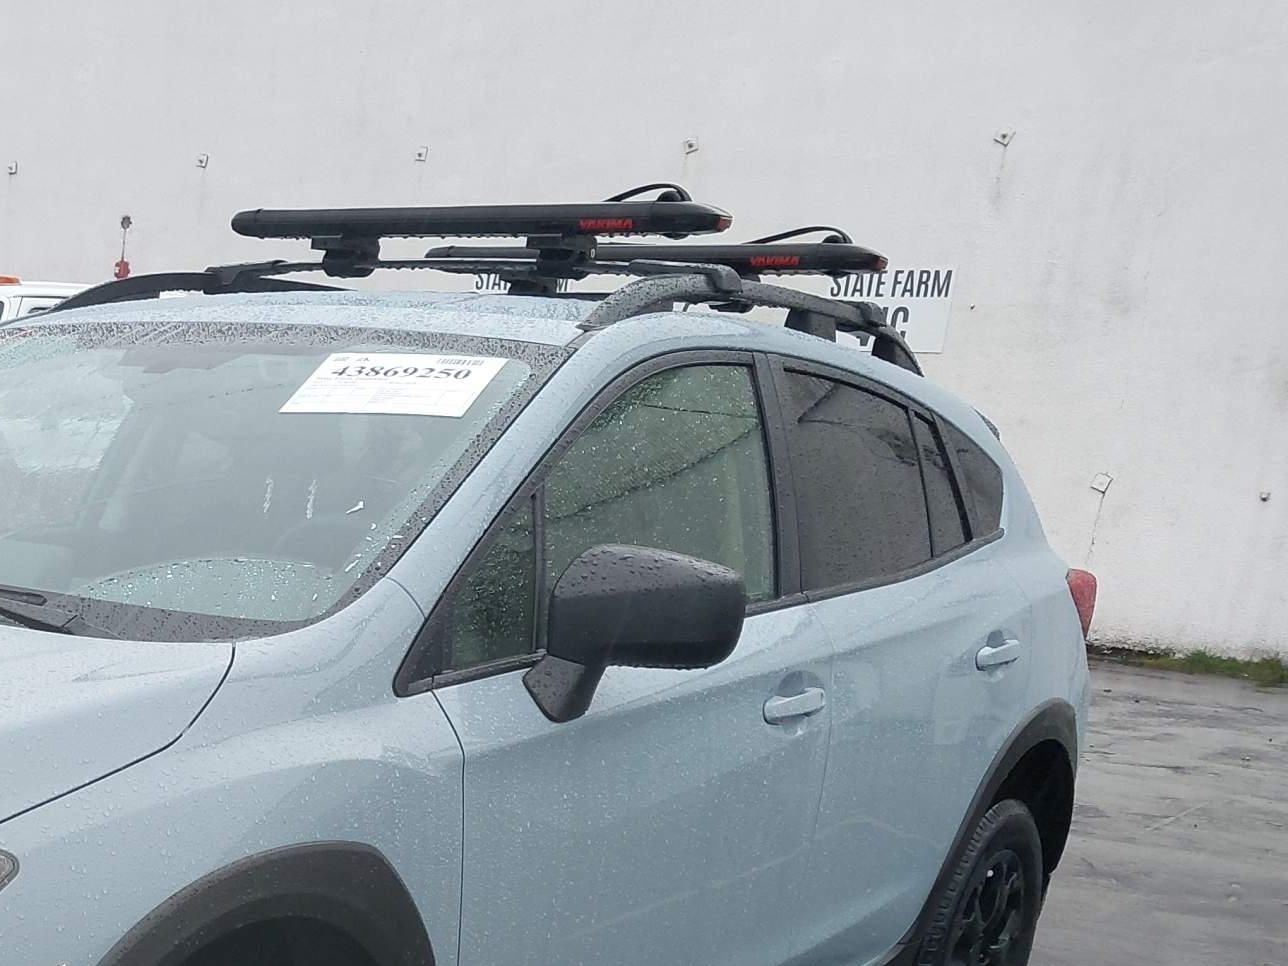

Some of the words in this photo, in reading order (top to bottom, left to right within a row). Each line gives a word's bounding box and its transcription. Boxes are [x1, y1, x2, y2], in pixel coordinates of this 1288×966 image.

[475, 273, 509, 291] STA
[830, 270, 887, 297] STATE
[891, 270, 953, 298] FARM
[331, 365, 472, 380] 43869250
